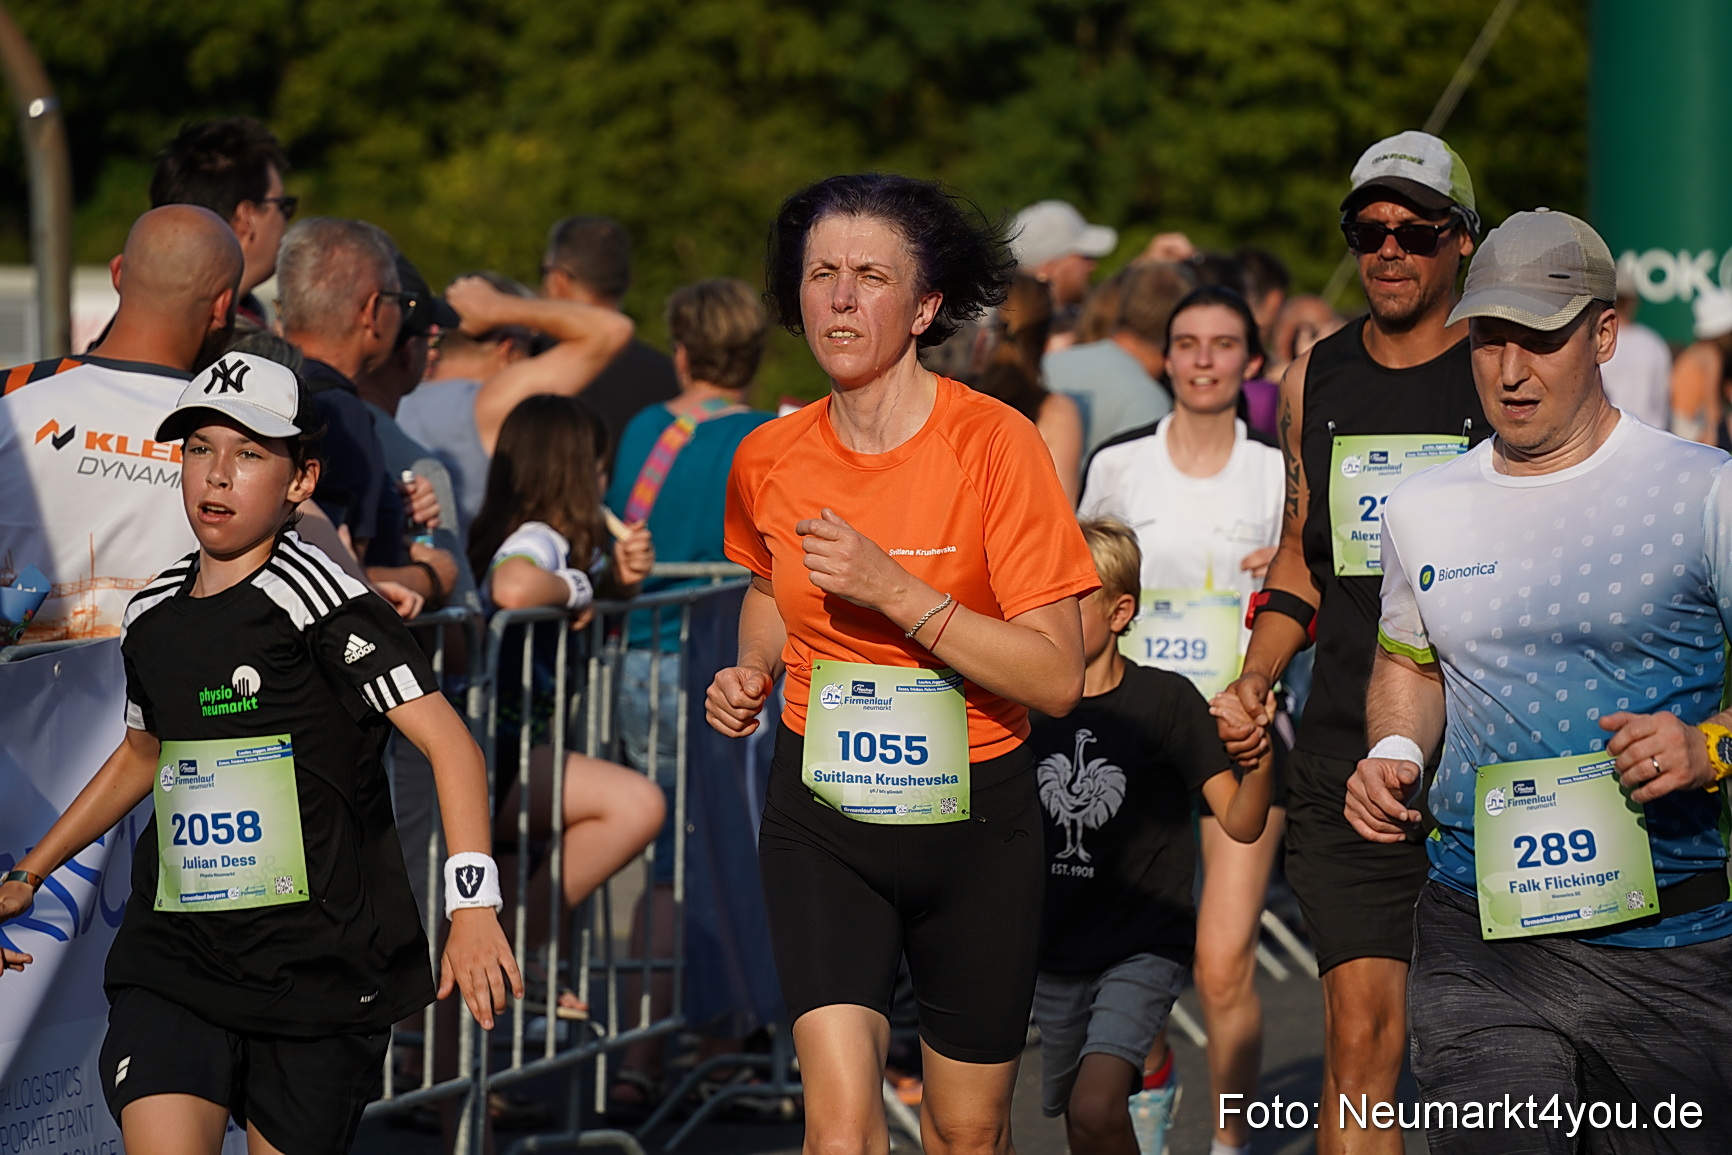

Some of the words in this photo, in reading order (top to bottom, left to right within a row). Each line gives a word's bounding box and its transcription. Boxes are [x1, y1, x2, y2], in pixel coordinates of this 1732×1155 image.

[203, 359, 251, 394] NY
[888, 548, 914, 557] Svitlana
[915, 545, 957, 556] Krushevska
[344, 642, 376, 665] adidas
[1144, 638, 1207, 660] 1239
[199, 685, 233, 704] physio
[844, 697, 893, 706] Firmenlauf
[202, 697, 259, 717] neumarkt
[837, 730, 929, 766] 1055
[175, 773, 215, 785] Firmenlauf
[188, 782, 215, 791] neumarkt
[813, 770, 872, 785] Svitlana
[875, 773, 959, 786] Krushevska
[1507, 792, 1556, 808] Firmenlauf
[1526, 801, 1557, 811] neumarkt
[843, 806, 894, 815] firmenlauf.bayern
[171, 810, 263, 846] 2058
[1513, 828, 1597, 869] 289
[182, 856, 218, 870] Julian
[221, 855, 257, 868] Dess
[1051, 863, 1095, 878] EST.1908
[1509, 878, 1541, 894] Falk
[1545, 869, 1620, 891] Flickinger
[1523, 912, 1579, 927] firmenlauf.bayern
[15, 1066, 82, 1111] LOGISTICS
[58, 1104, 94, 1142] PRINT
